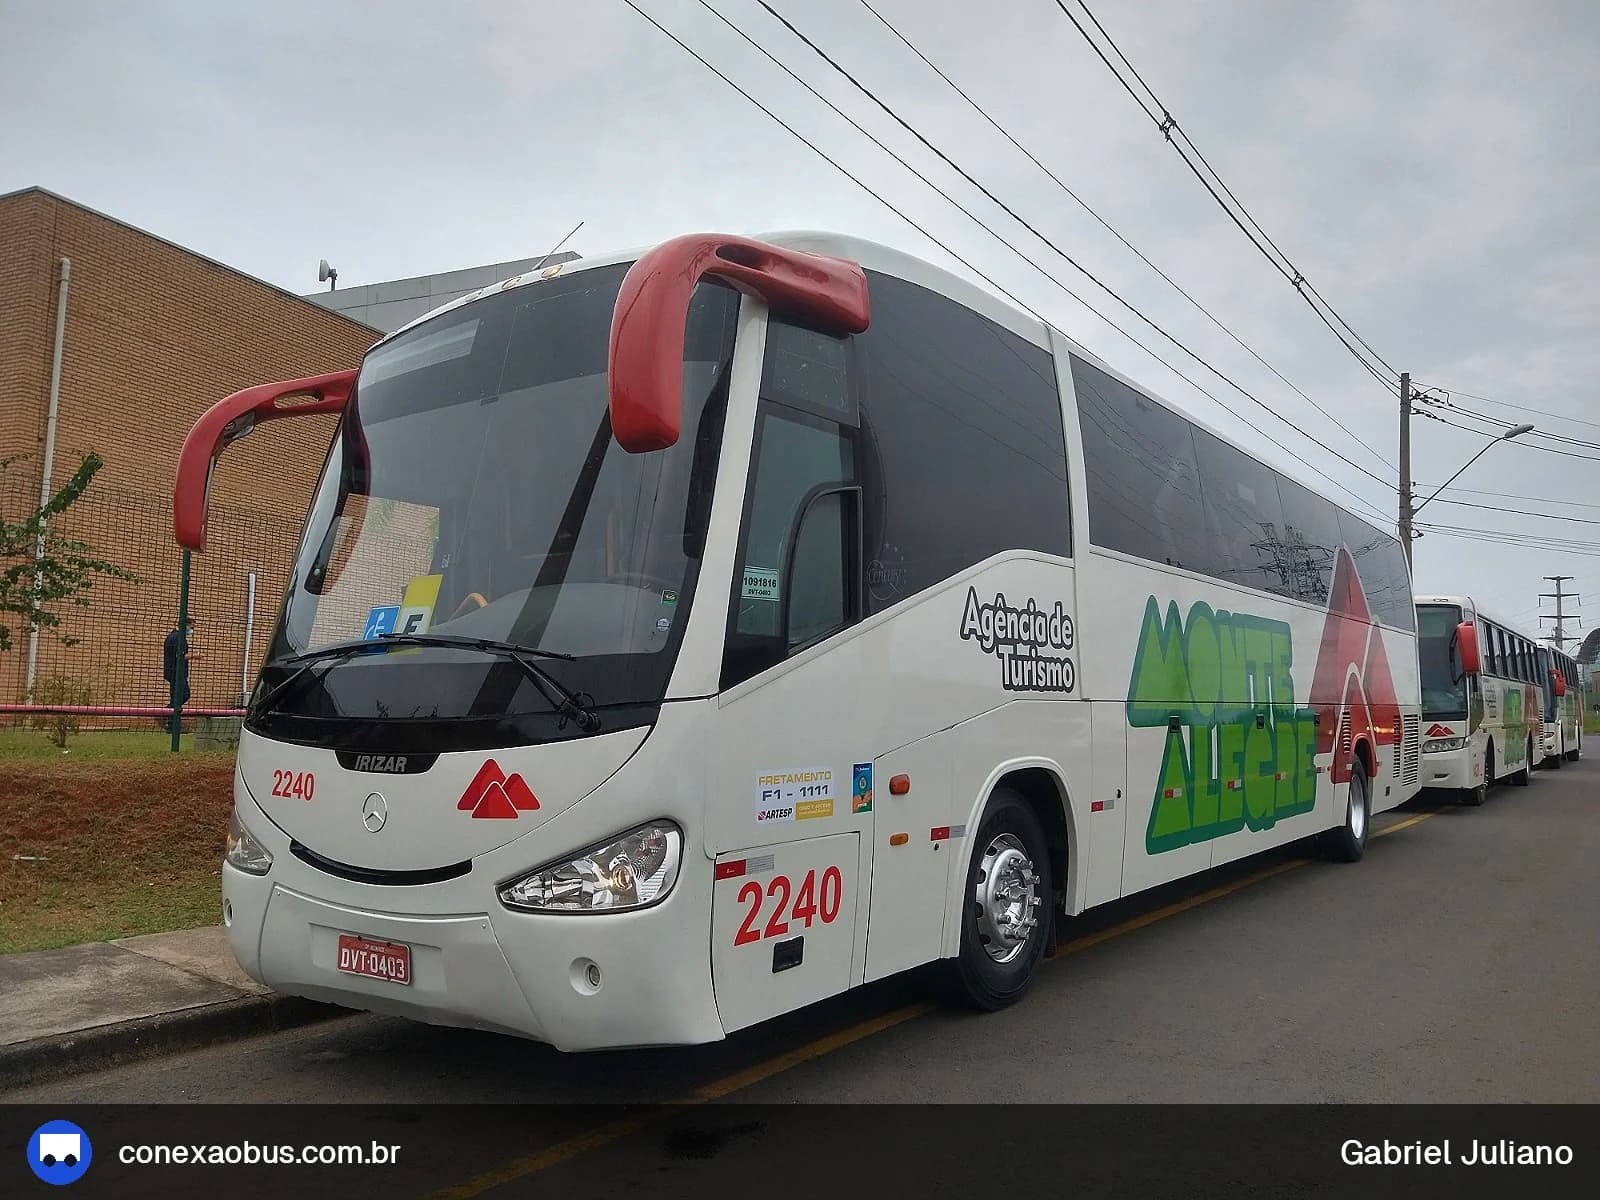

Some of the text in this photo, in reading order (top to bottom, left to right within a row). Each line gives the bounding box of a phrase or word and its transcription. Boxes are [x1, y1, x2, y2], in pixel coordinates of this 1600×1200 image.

[743, 576, 777, 588] 1091816
[961, 586, 1073, 653] Agência de
[996, 644, 1075, 693] Turismo
[1127, 595, 1294, 727] MONTE
[354, 755, 408, 773] IRIZAR
[758, 771, 832, 786] FRETAMENTO
[272, 770, 314, 801] 2240
[762, 789, 781, 801] F1
[800, 785, 828, 797] 1111
[1146, 705, 1318, 855] ALEGRE
[765, 808, 793, 820] ARTESP
[734, 866, 842, 947] 2240
